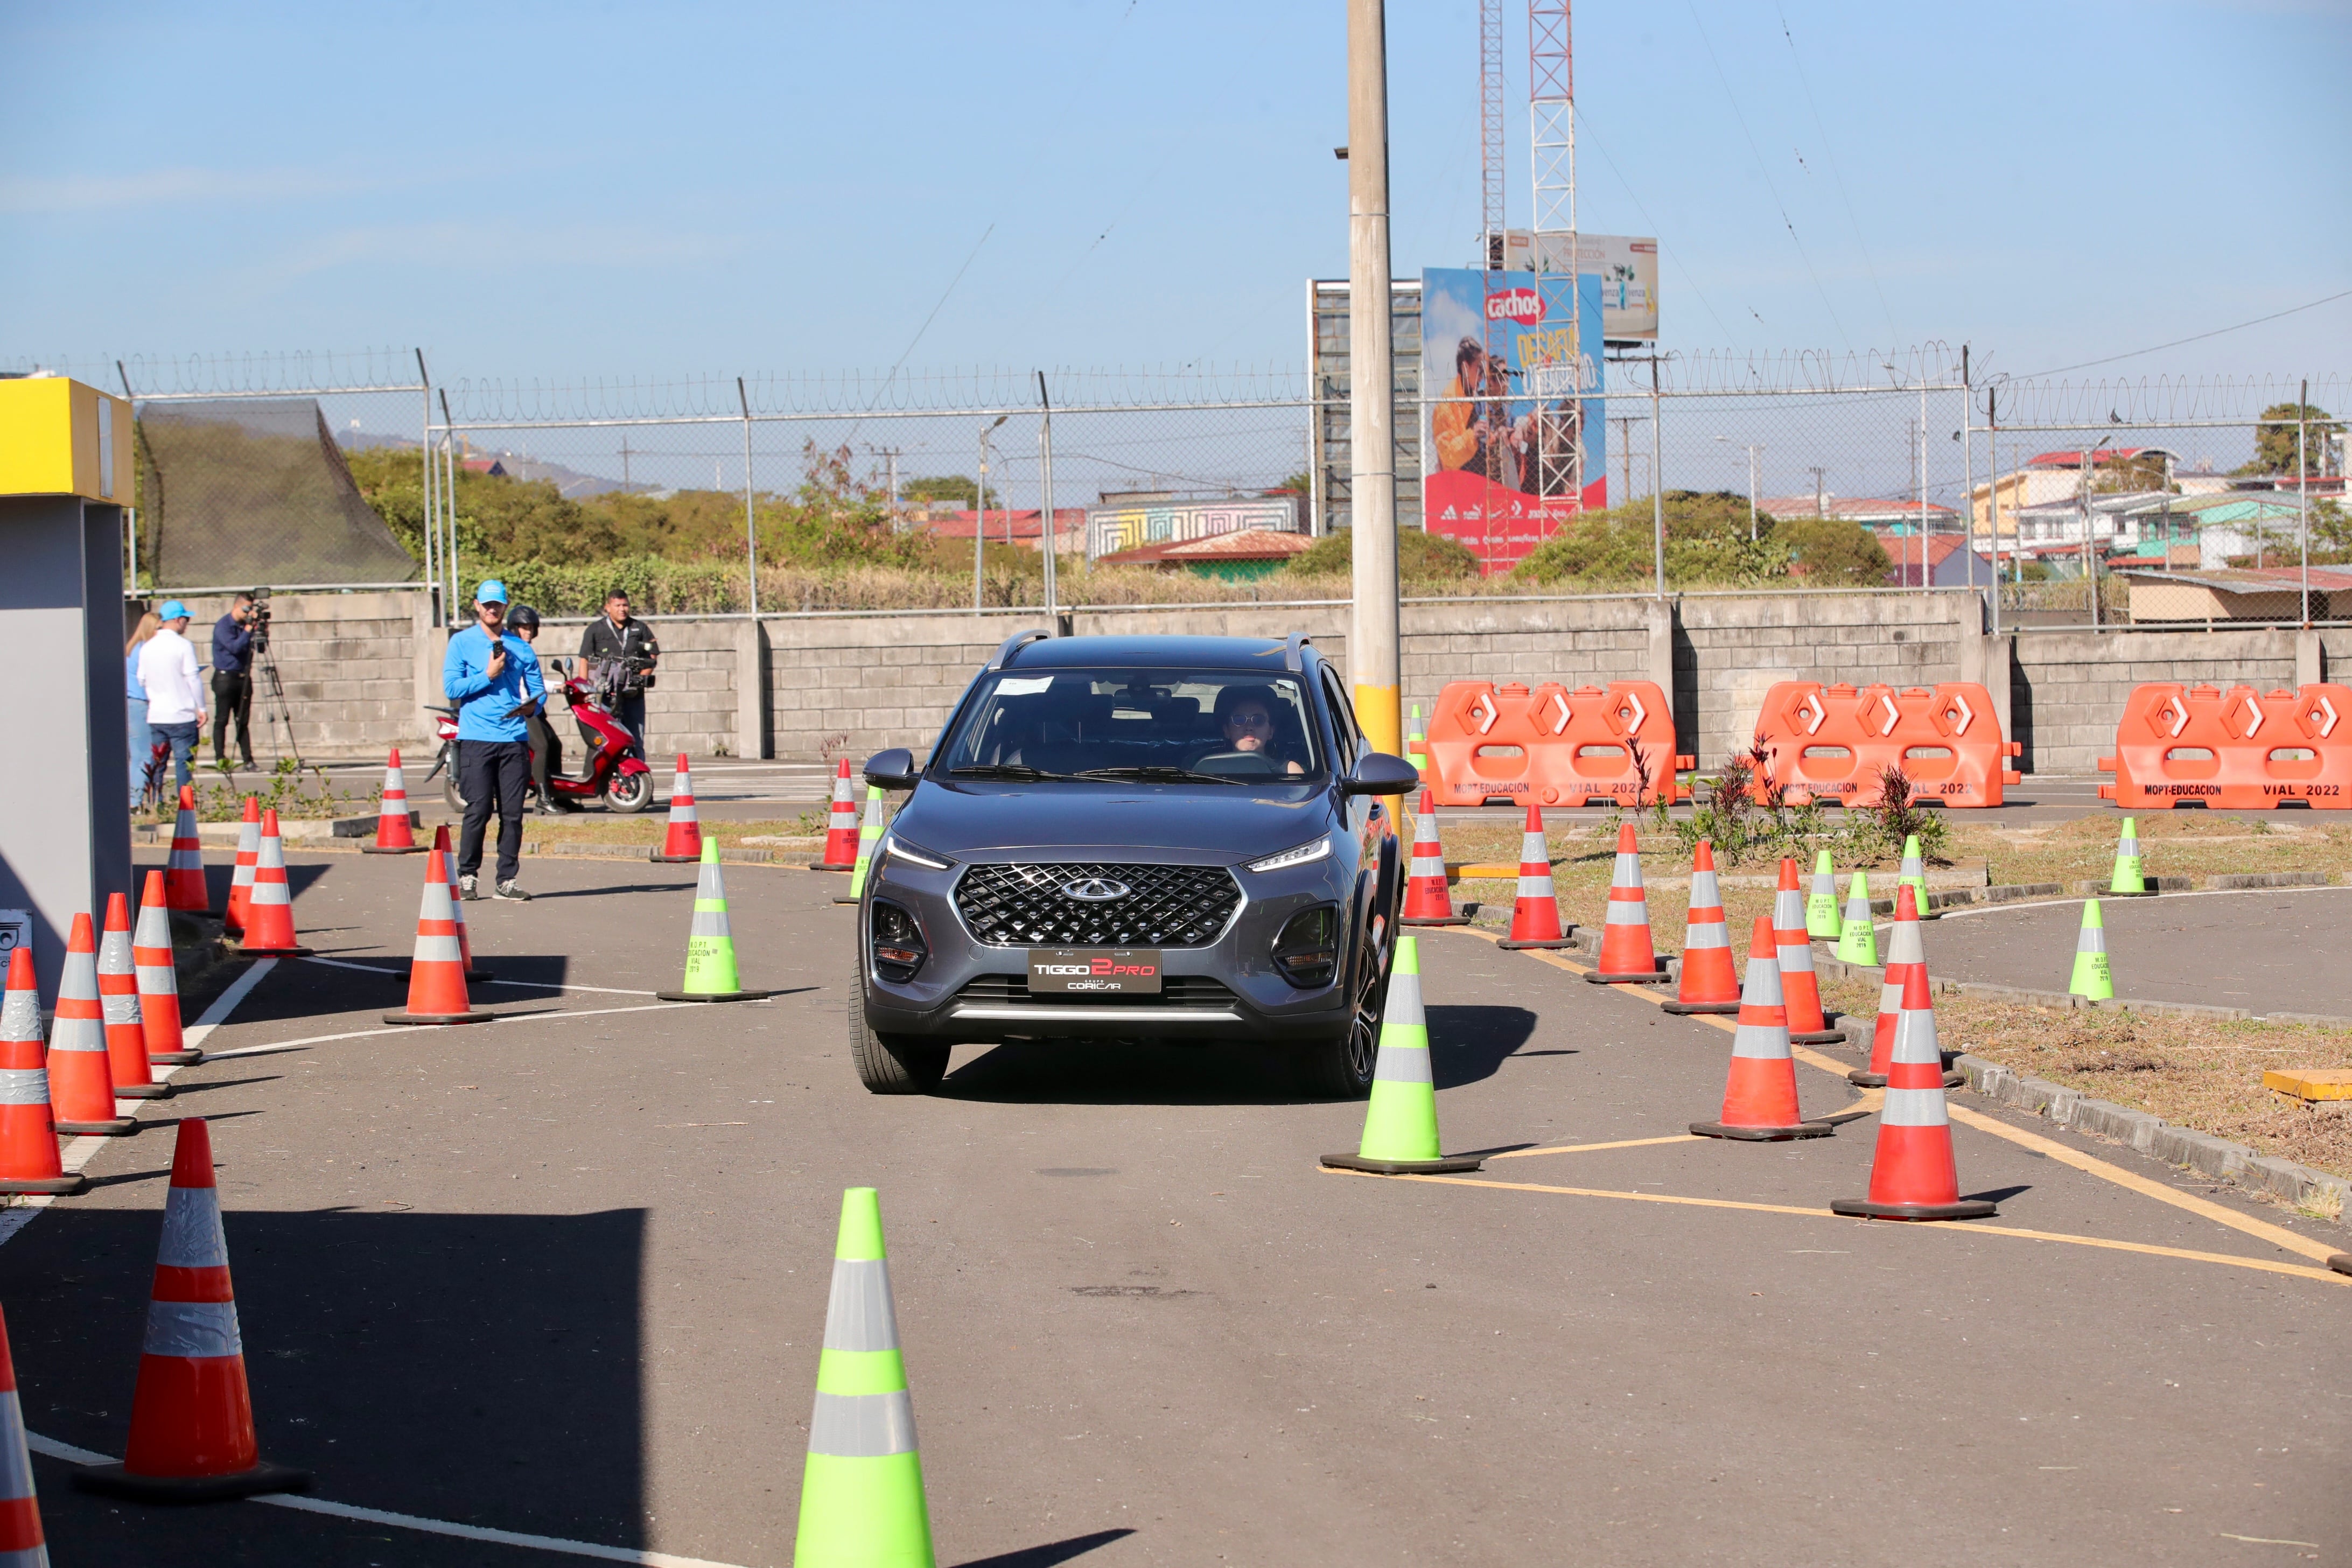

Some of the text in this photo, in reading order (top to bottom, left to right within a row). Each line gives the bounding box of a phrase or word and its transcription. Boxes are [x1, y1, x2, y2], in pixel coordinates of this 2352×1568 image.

[1570, 783, 1601, 793] VIAL
[1940, 783, 1972, 794] 2022
[2263, 785, 2295, 795] VIAL
[2306, 785, 2339, 796] 2022
